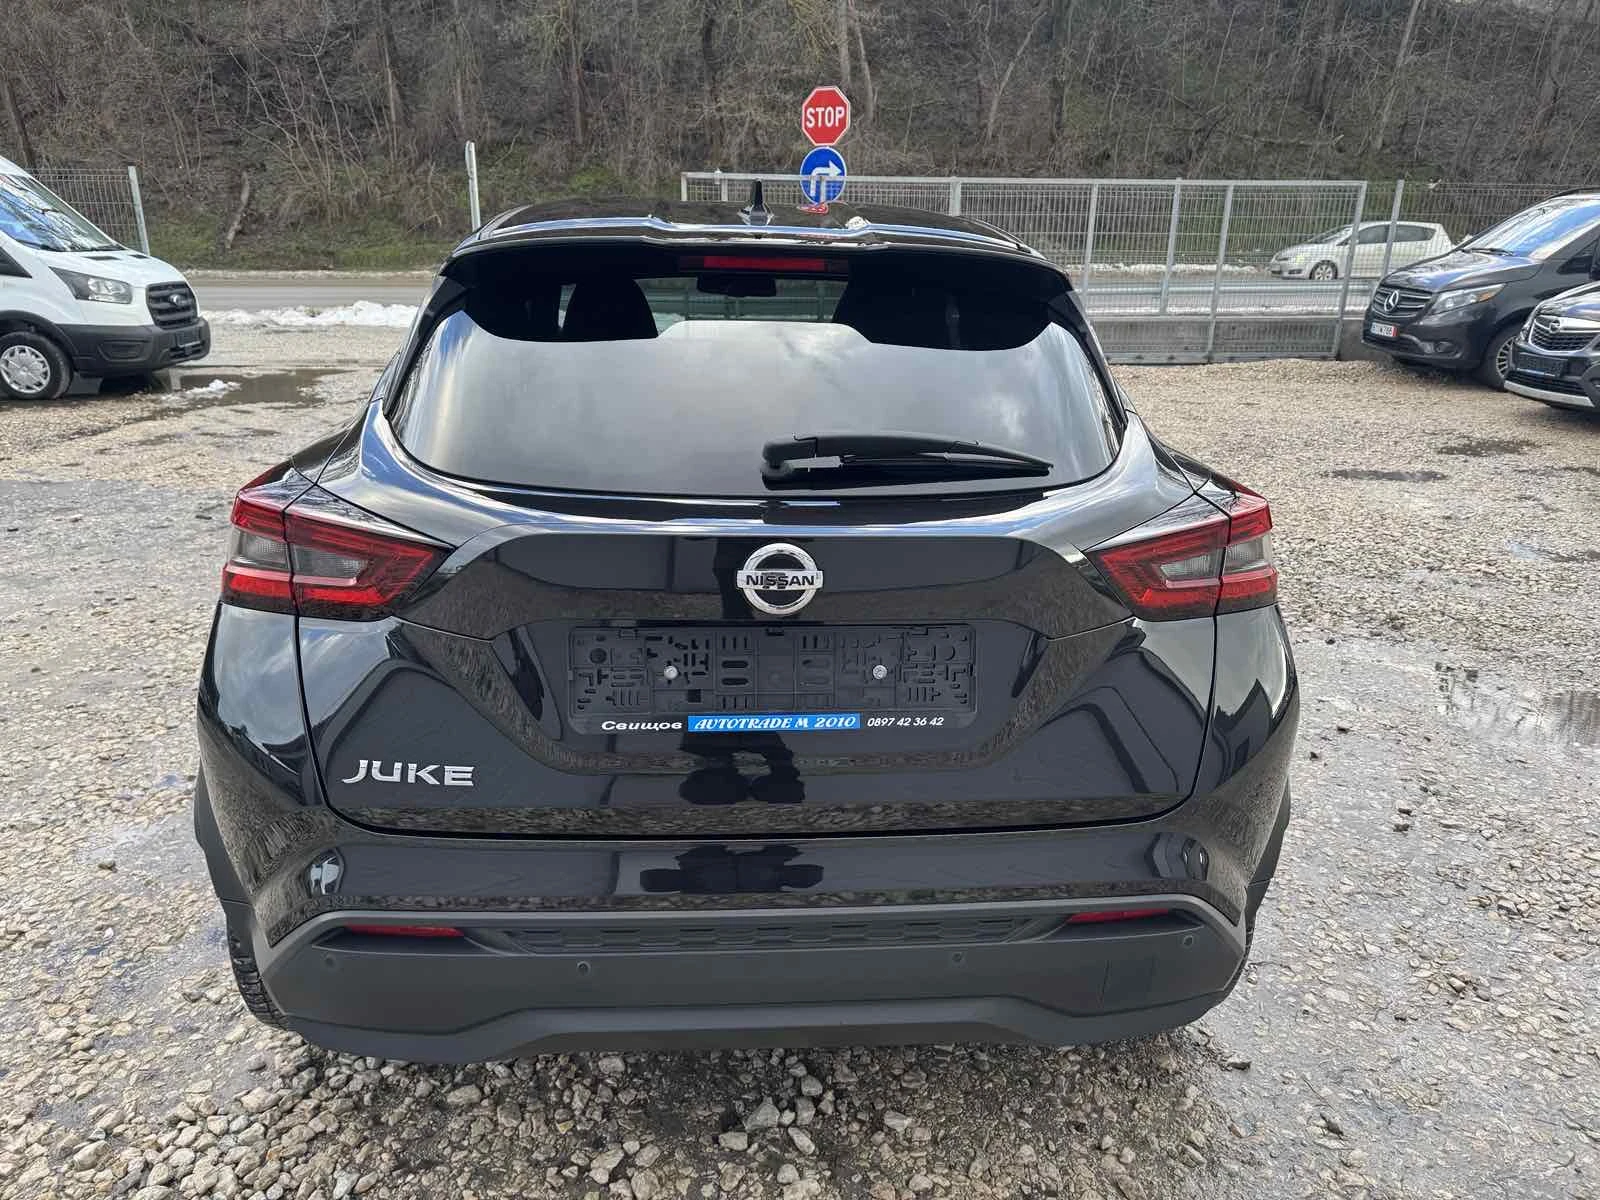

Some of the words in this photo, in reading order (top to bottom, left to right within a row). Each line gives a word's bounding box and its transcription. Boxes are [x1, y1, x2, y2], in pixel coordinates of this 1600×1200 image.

[806, 107, 845, 128] STOP
[746, 575, 815, 586] NISSAN
[601, 721, 683, 731] Свищов
[694, 718, 791, 729] AUTOTRADE
[795, 718, 808, 729] M
[815, 717, 856, 728] 2010
[867, 717, 895, 727] 0897
[896, 717, 912, 727] 42
[913, 717, 927, 726] 36
[929, 717, 944, 726] 42
[341, 759, 475, 786] JUKE
